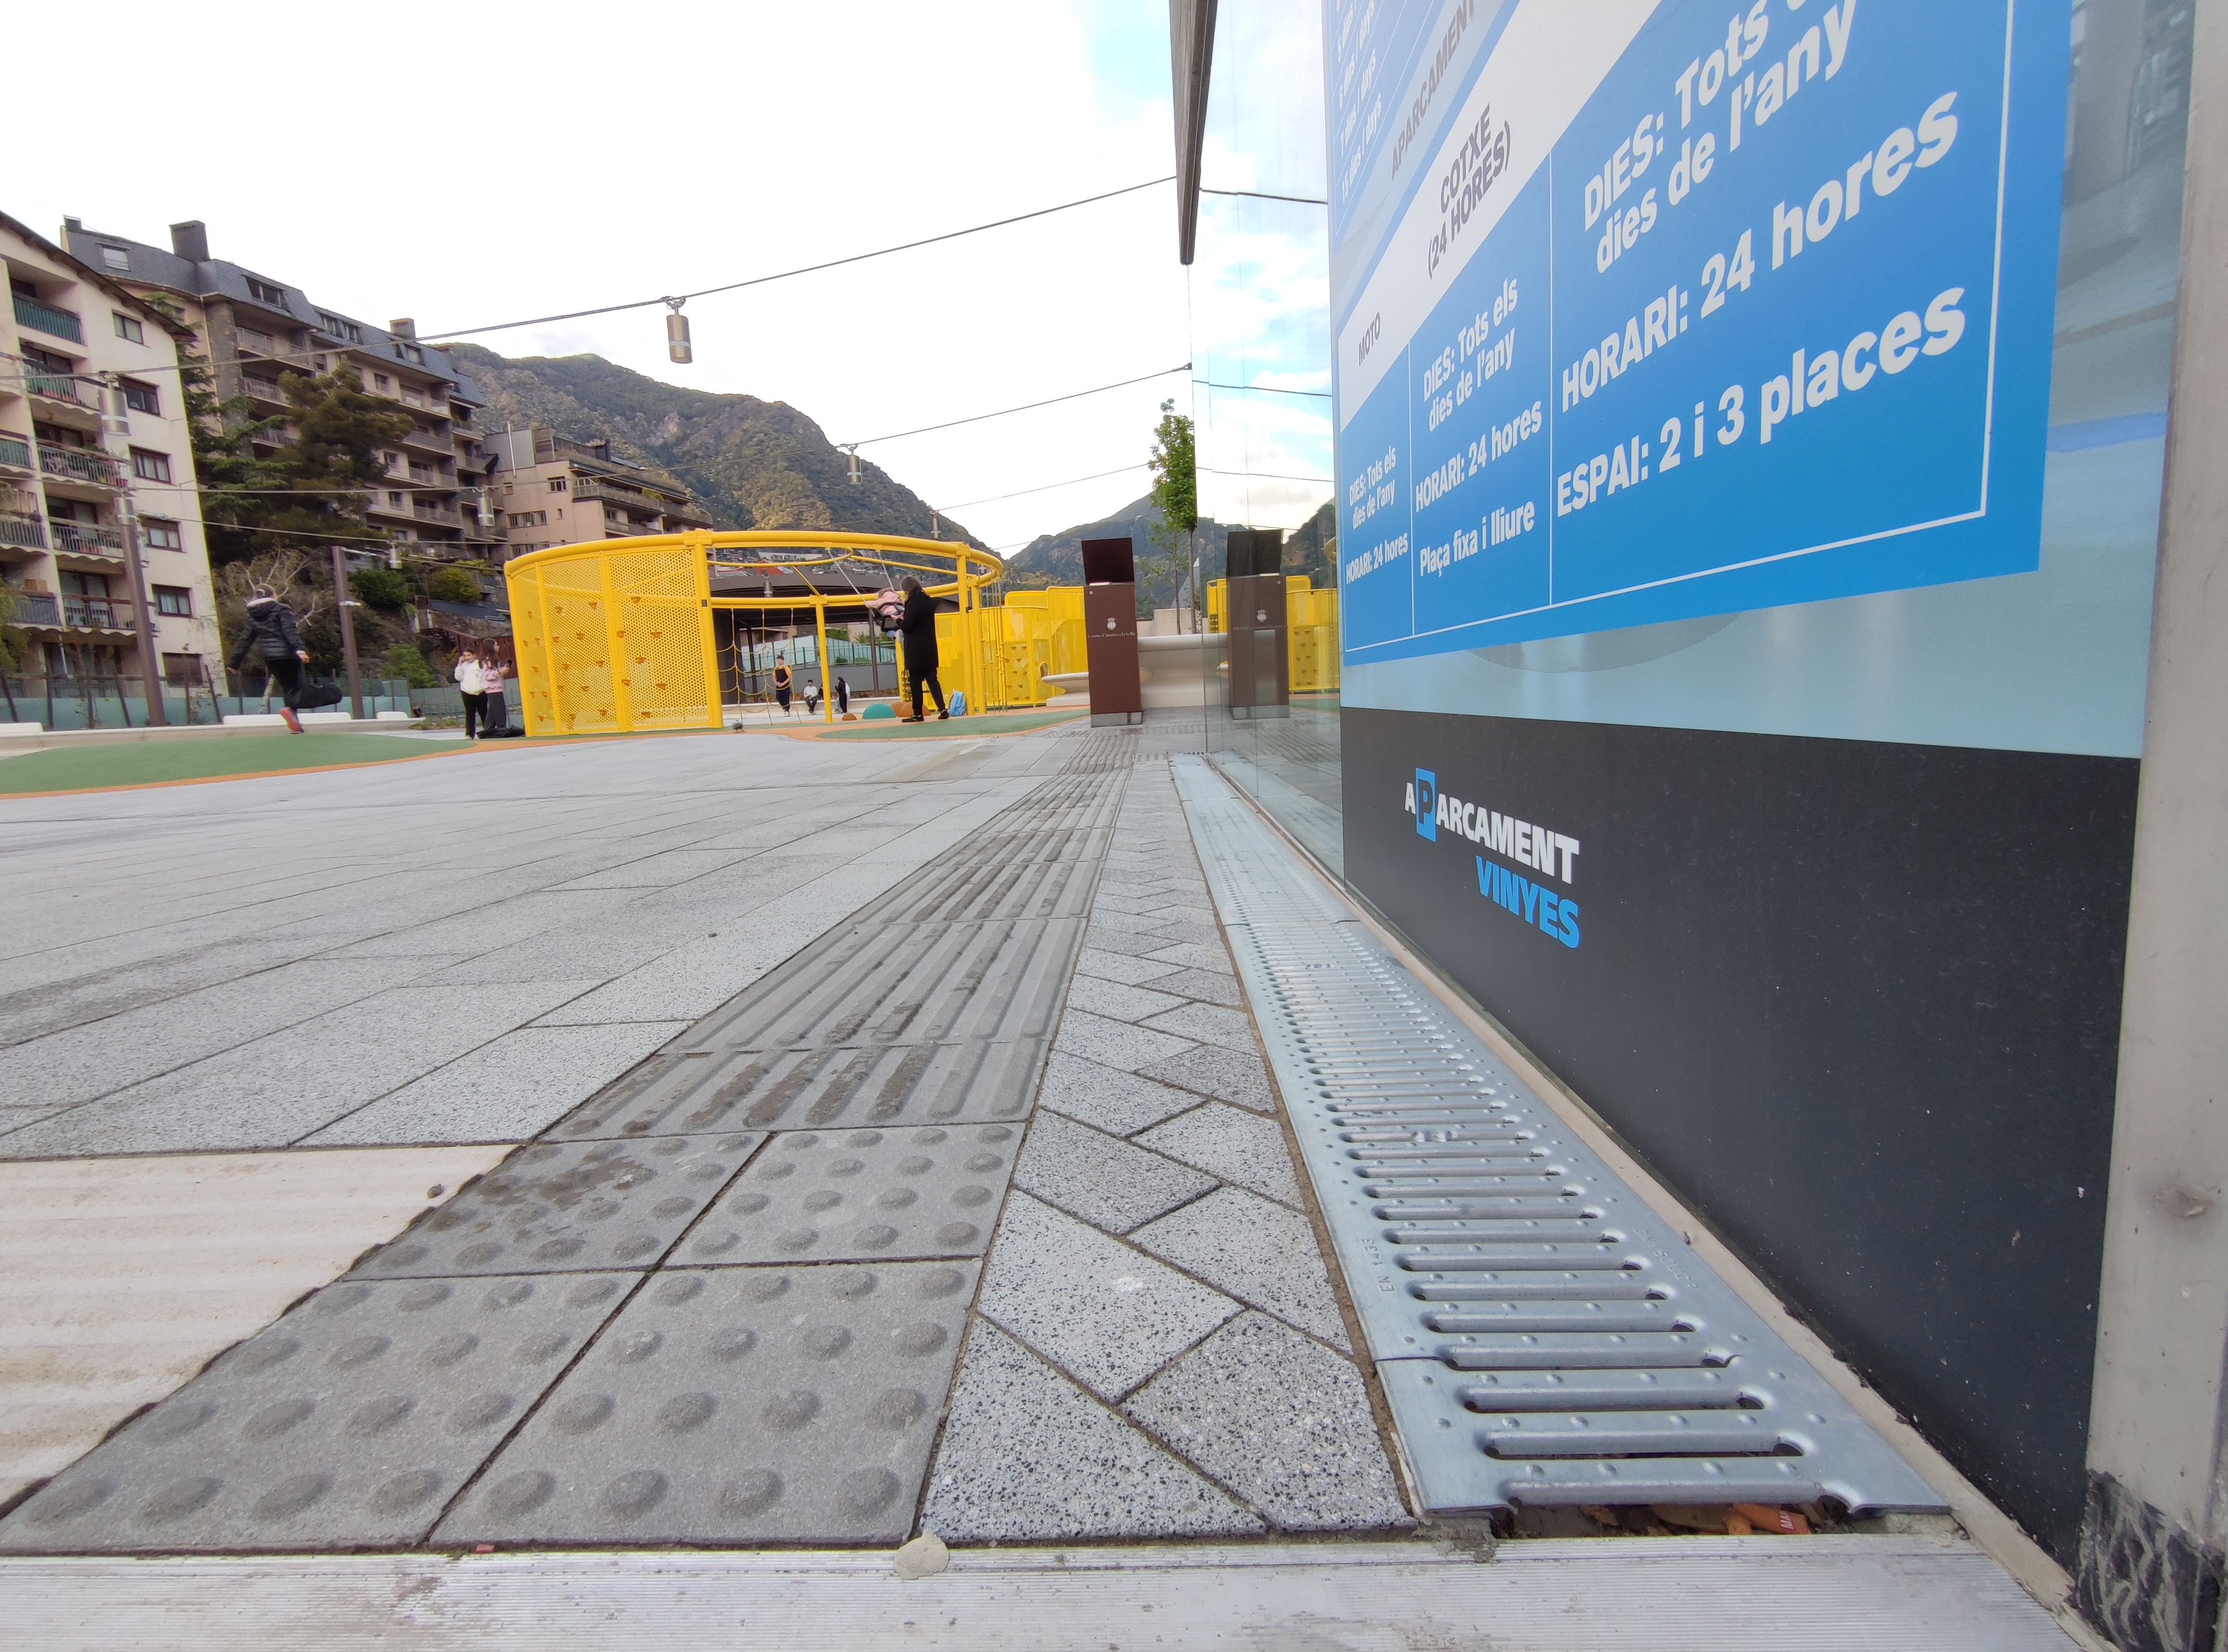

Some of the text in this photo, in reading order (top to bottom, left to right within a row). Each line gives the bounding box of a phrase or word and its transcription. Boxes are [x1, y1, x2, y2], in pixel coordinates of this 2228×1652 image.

[1441, 102, 1490, 214] COTXE
[1585, 0, 1769, 232] DIES: Tots
[1596, 0, 1856, 274] dies de l'any
[1428, 120, 1511, 280] (24 HORES)
[1562, 92, 1958, 413] HORARI: 24 hores
[1358, 311, 1381, 366] MOTO
[1423, 278, 1517, 402] DIES: Tots els
[1429, 327, 1515, 432] dies de l'any
[1557, 286, 1965, 517] ESPAI: 2 i 3 places
[1349, 445, 1396, 507] DIES: Tots els
[1352, 479, 1395, 530] dies de l'any
[1415, 401, 1542, 513] HORARI: 24 hores
[1346, 532, 1408, 584] HORARI: 24 hores
[1420, 501, 1535, 578] Plaça fixa i lliure
[1405, 776, 1580, 885] APARCAMENT
[1476, 855, 1579, 948] VINYES
